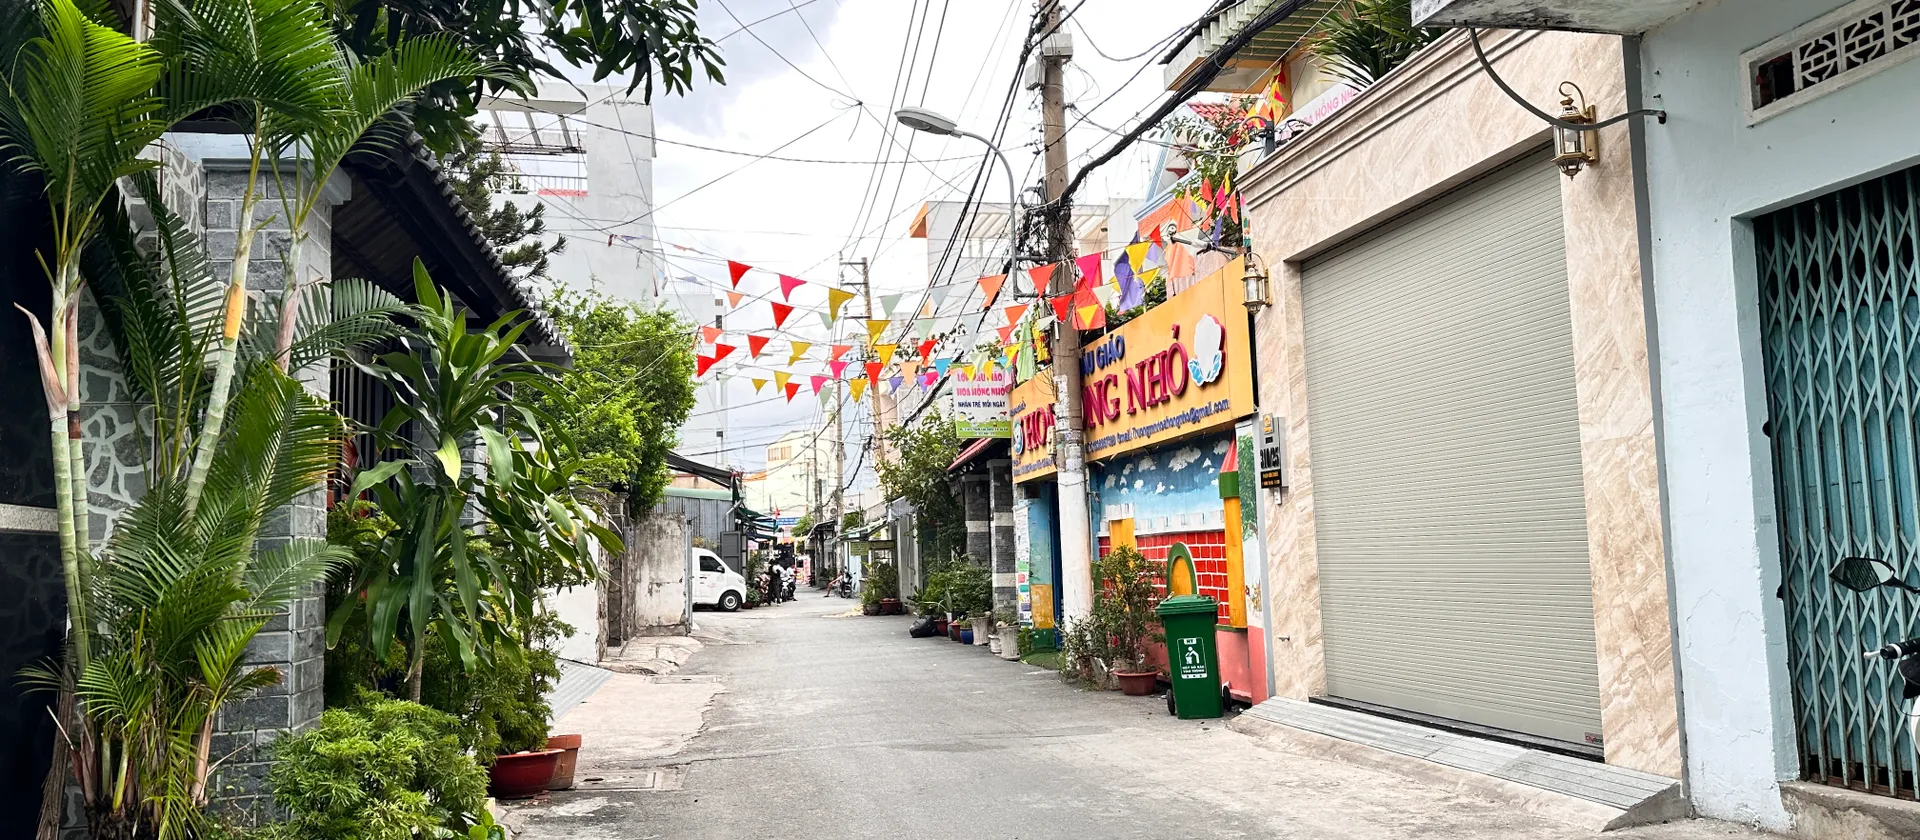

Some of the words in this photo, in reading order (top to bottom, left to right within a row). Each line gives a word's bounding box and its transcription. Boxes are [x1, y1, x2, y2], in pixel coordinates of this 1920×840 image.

[1096, 333, 1125, 369] GIÁO
[1125, 323, 1189, 414] NHỎ
[956, 387, 971, 396] HOA
[972, 383, 990, 396] HỒNG
